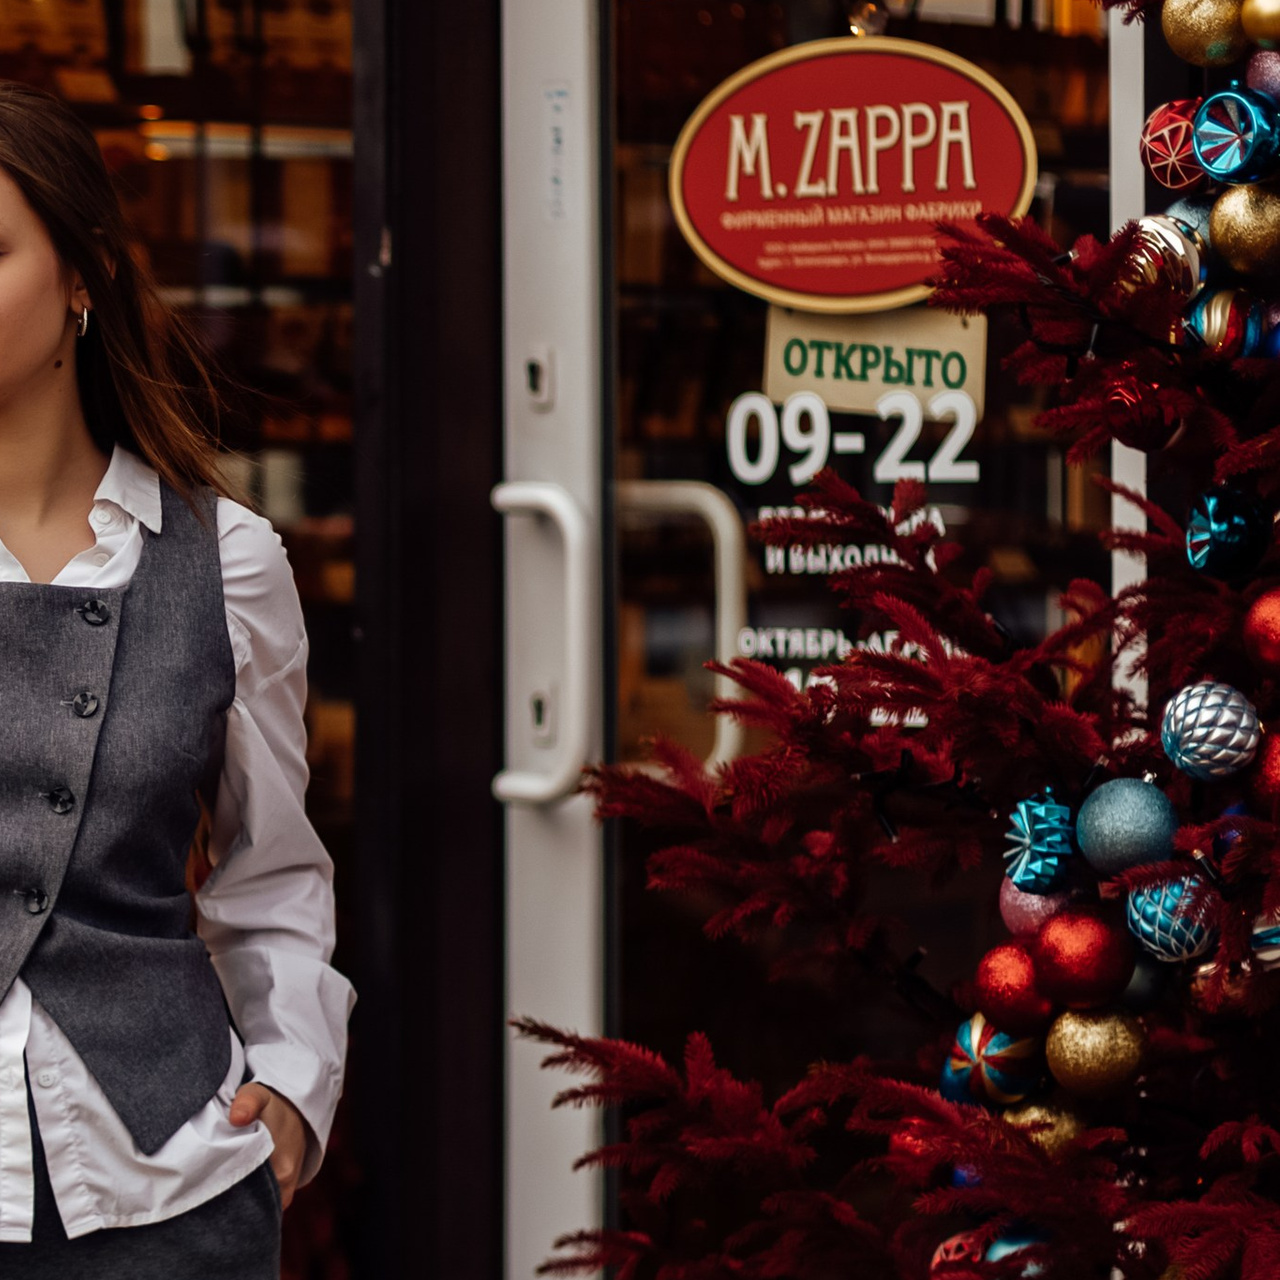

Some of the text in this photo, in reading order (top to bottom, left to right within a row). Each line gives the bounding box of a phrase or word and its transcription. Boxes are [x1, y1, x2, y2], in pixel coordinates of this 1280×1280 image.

[725, 100, 977, 202] M. ZAPPA
[827, 203, 902, 226] МАГАЗИН
[904, 200, 983, 222] ФАБРИКИ
[783, 337, 968, 390] ОТКРЫТО
[726, 389, 980, 486] 09-22
